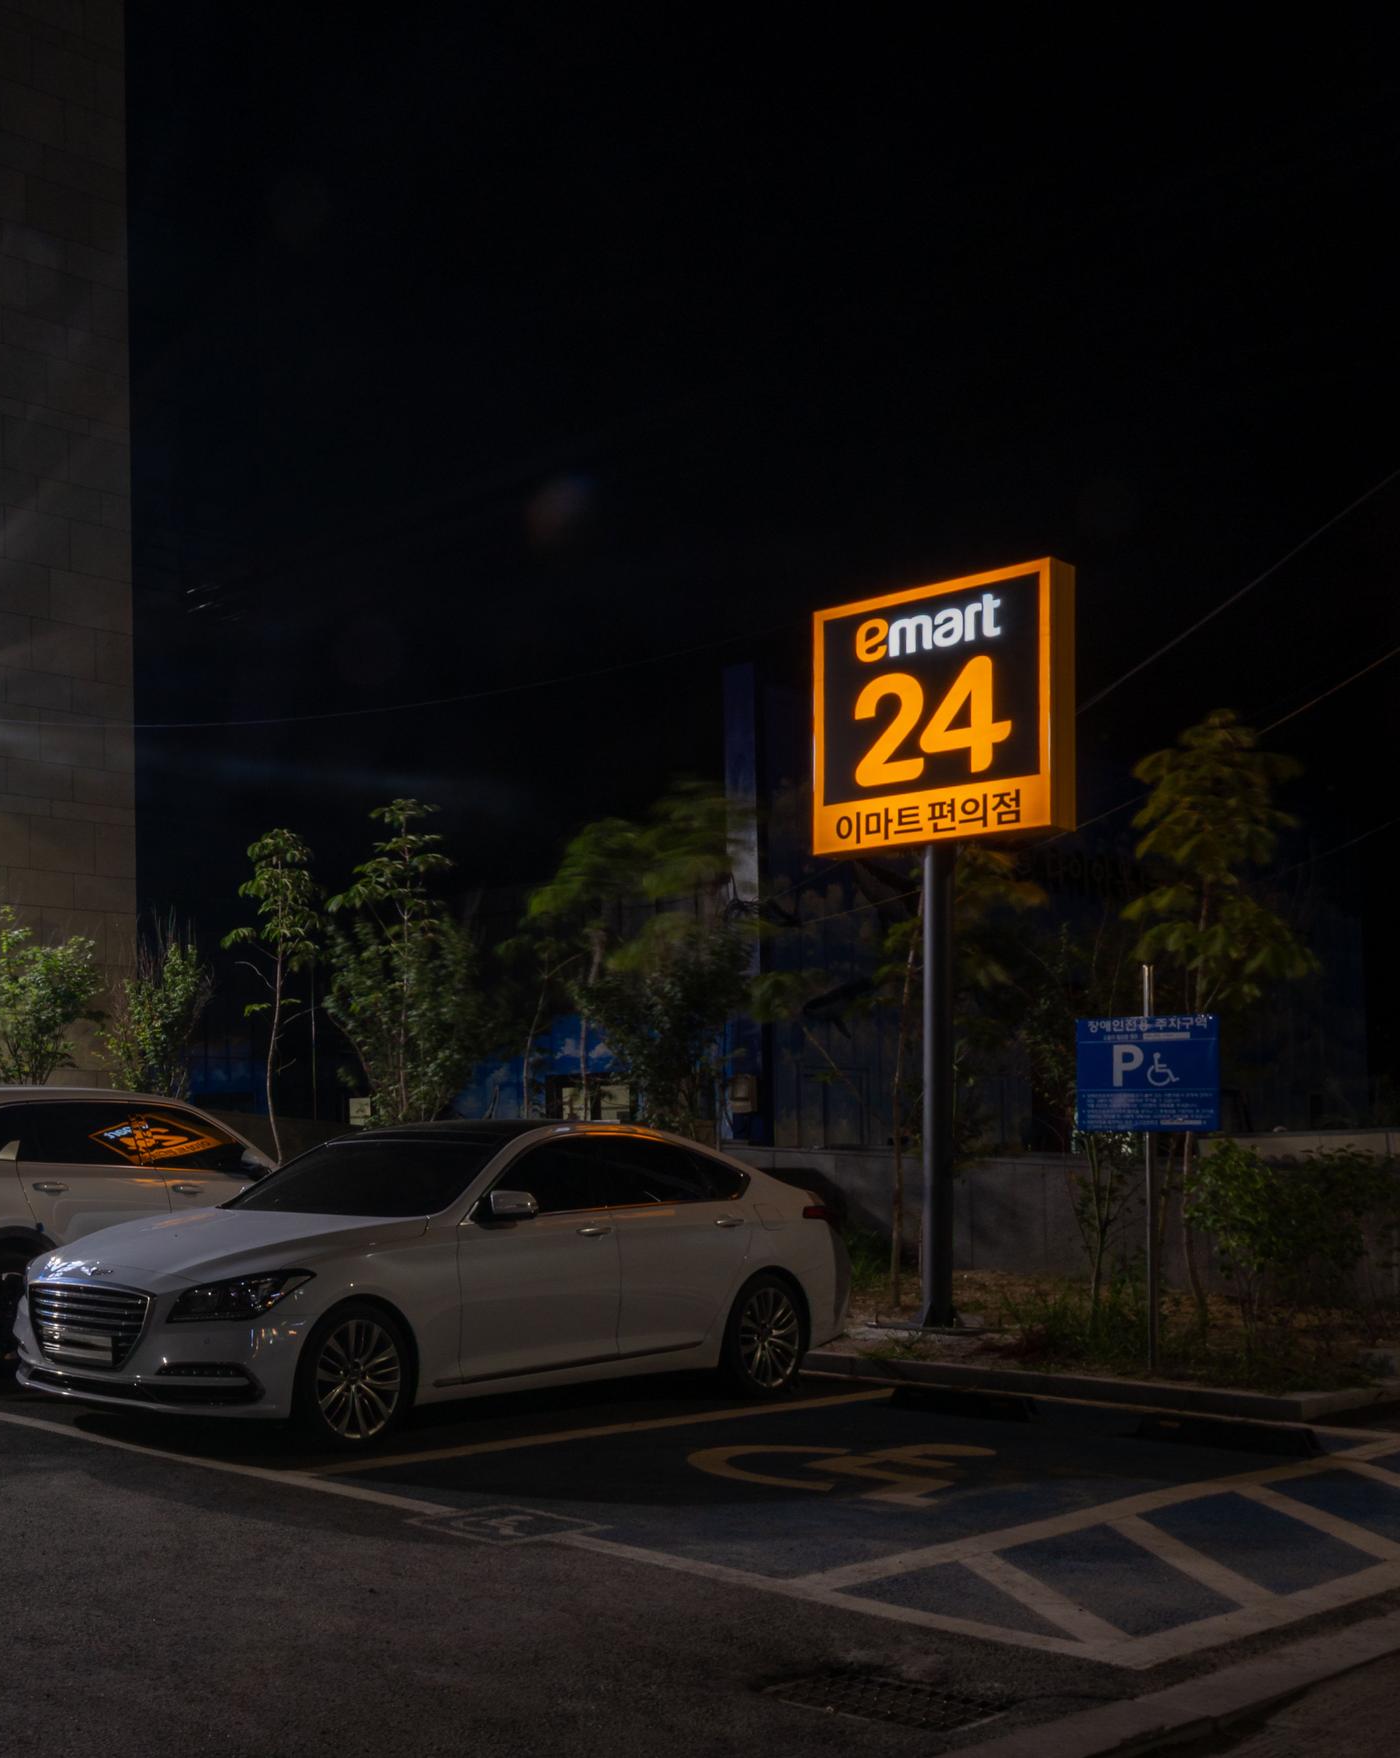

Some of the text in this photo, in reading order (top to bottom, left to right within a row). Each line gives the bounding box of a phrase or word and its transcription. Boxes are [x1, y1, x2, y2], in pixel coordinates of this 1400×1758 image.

[855, 593, 1001, 663] emart
[854, 655, 1012, 788] 24
[1112, 1044, 1145, 1088] P
